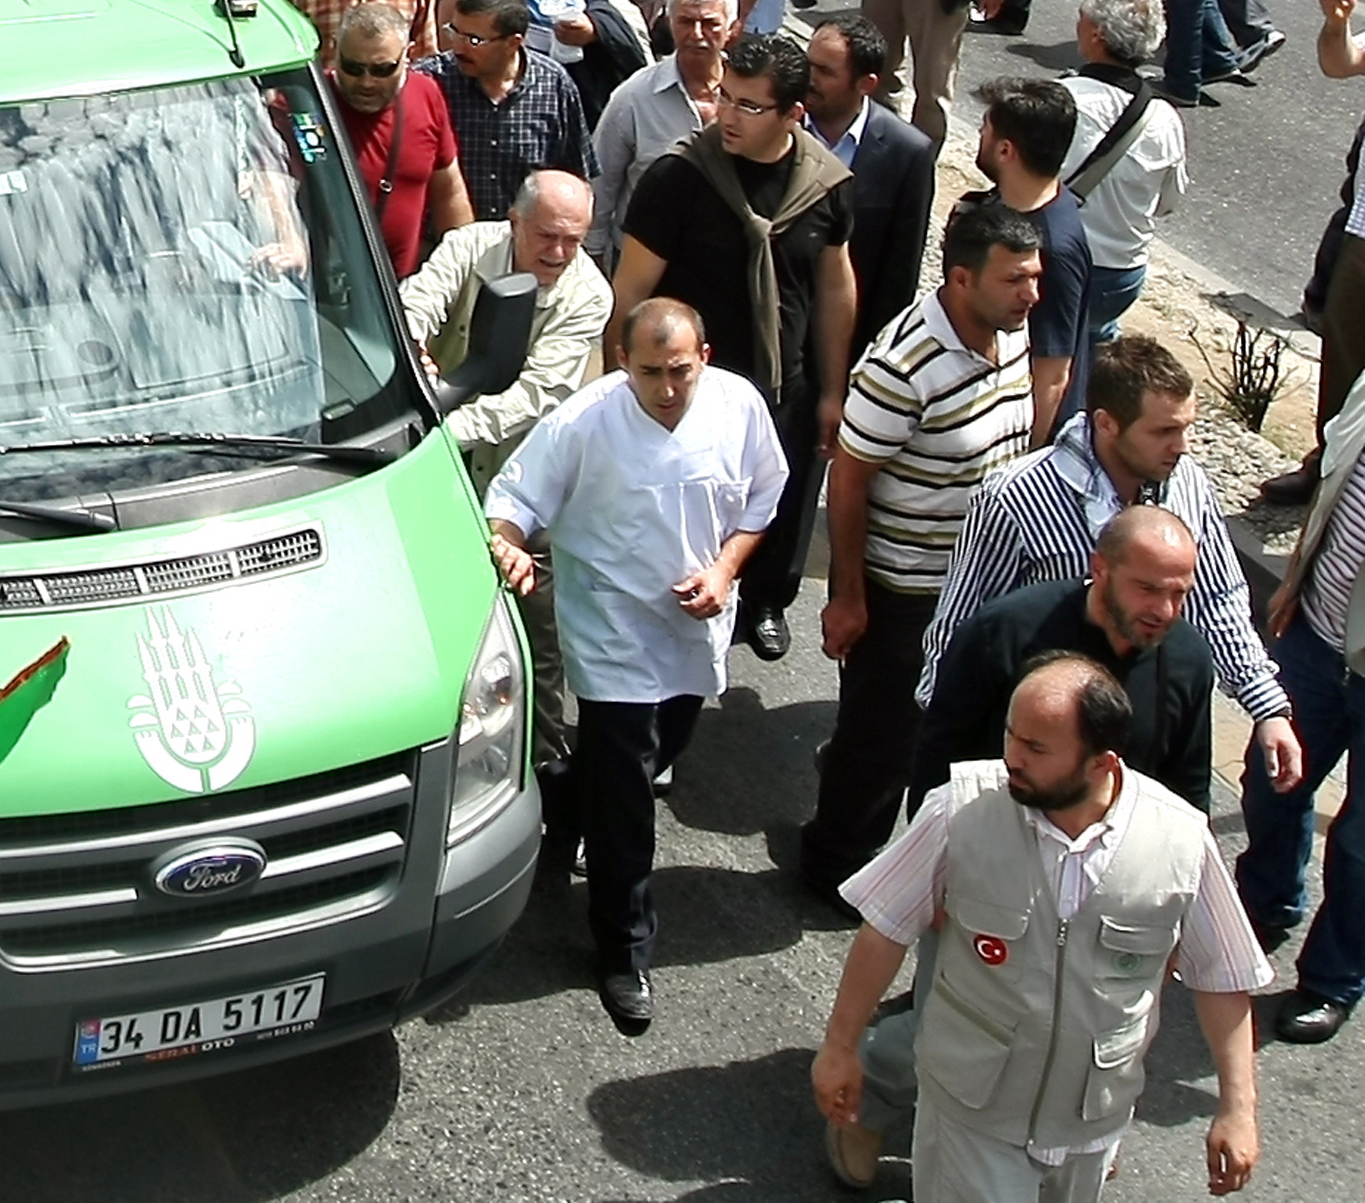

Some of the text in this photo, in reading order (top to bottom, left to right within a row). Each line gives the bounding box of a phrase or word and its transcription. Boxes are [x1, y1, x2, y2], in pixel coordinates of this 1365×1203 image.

[183, 861, 243, 892] Ford
[81, 1043, 98, 1055] TR
[101, 1019, 144, 1054] 34
[160, 1007, 202, 1045] DA
[222, 985, 313, 1032] 5117
[200, 1037, 236, 1052] OTO
